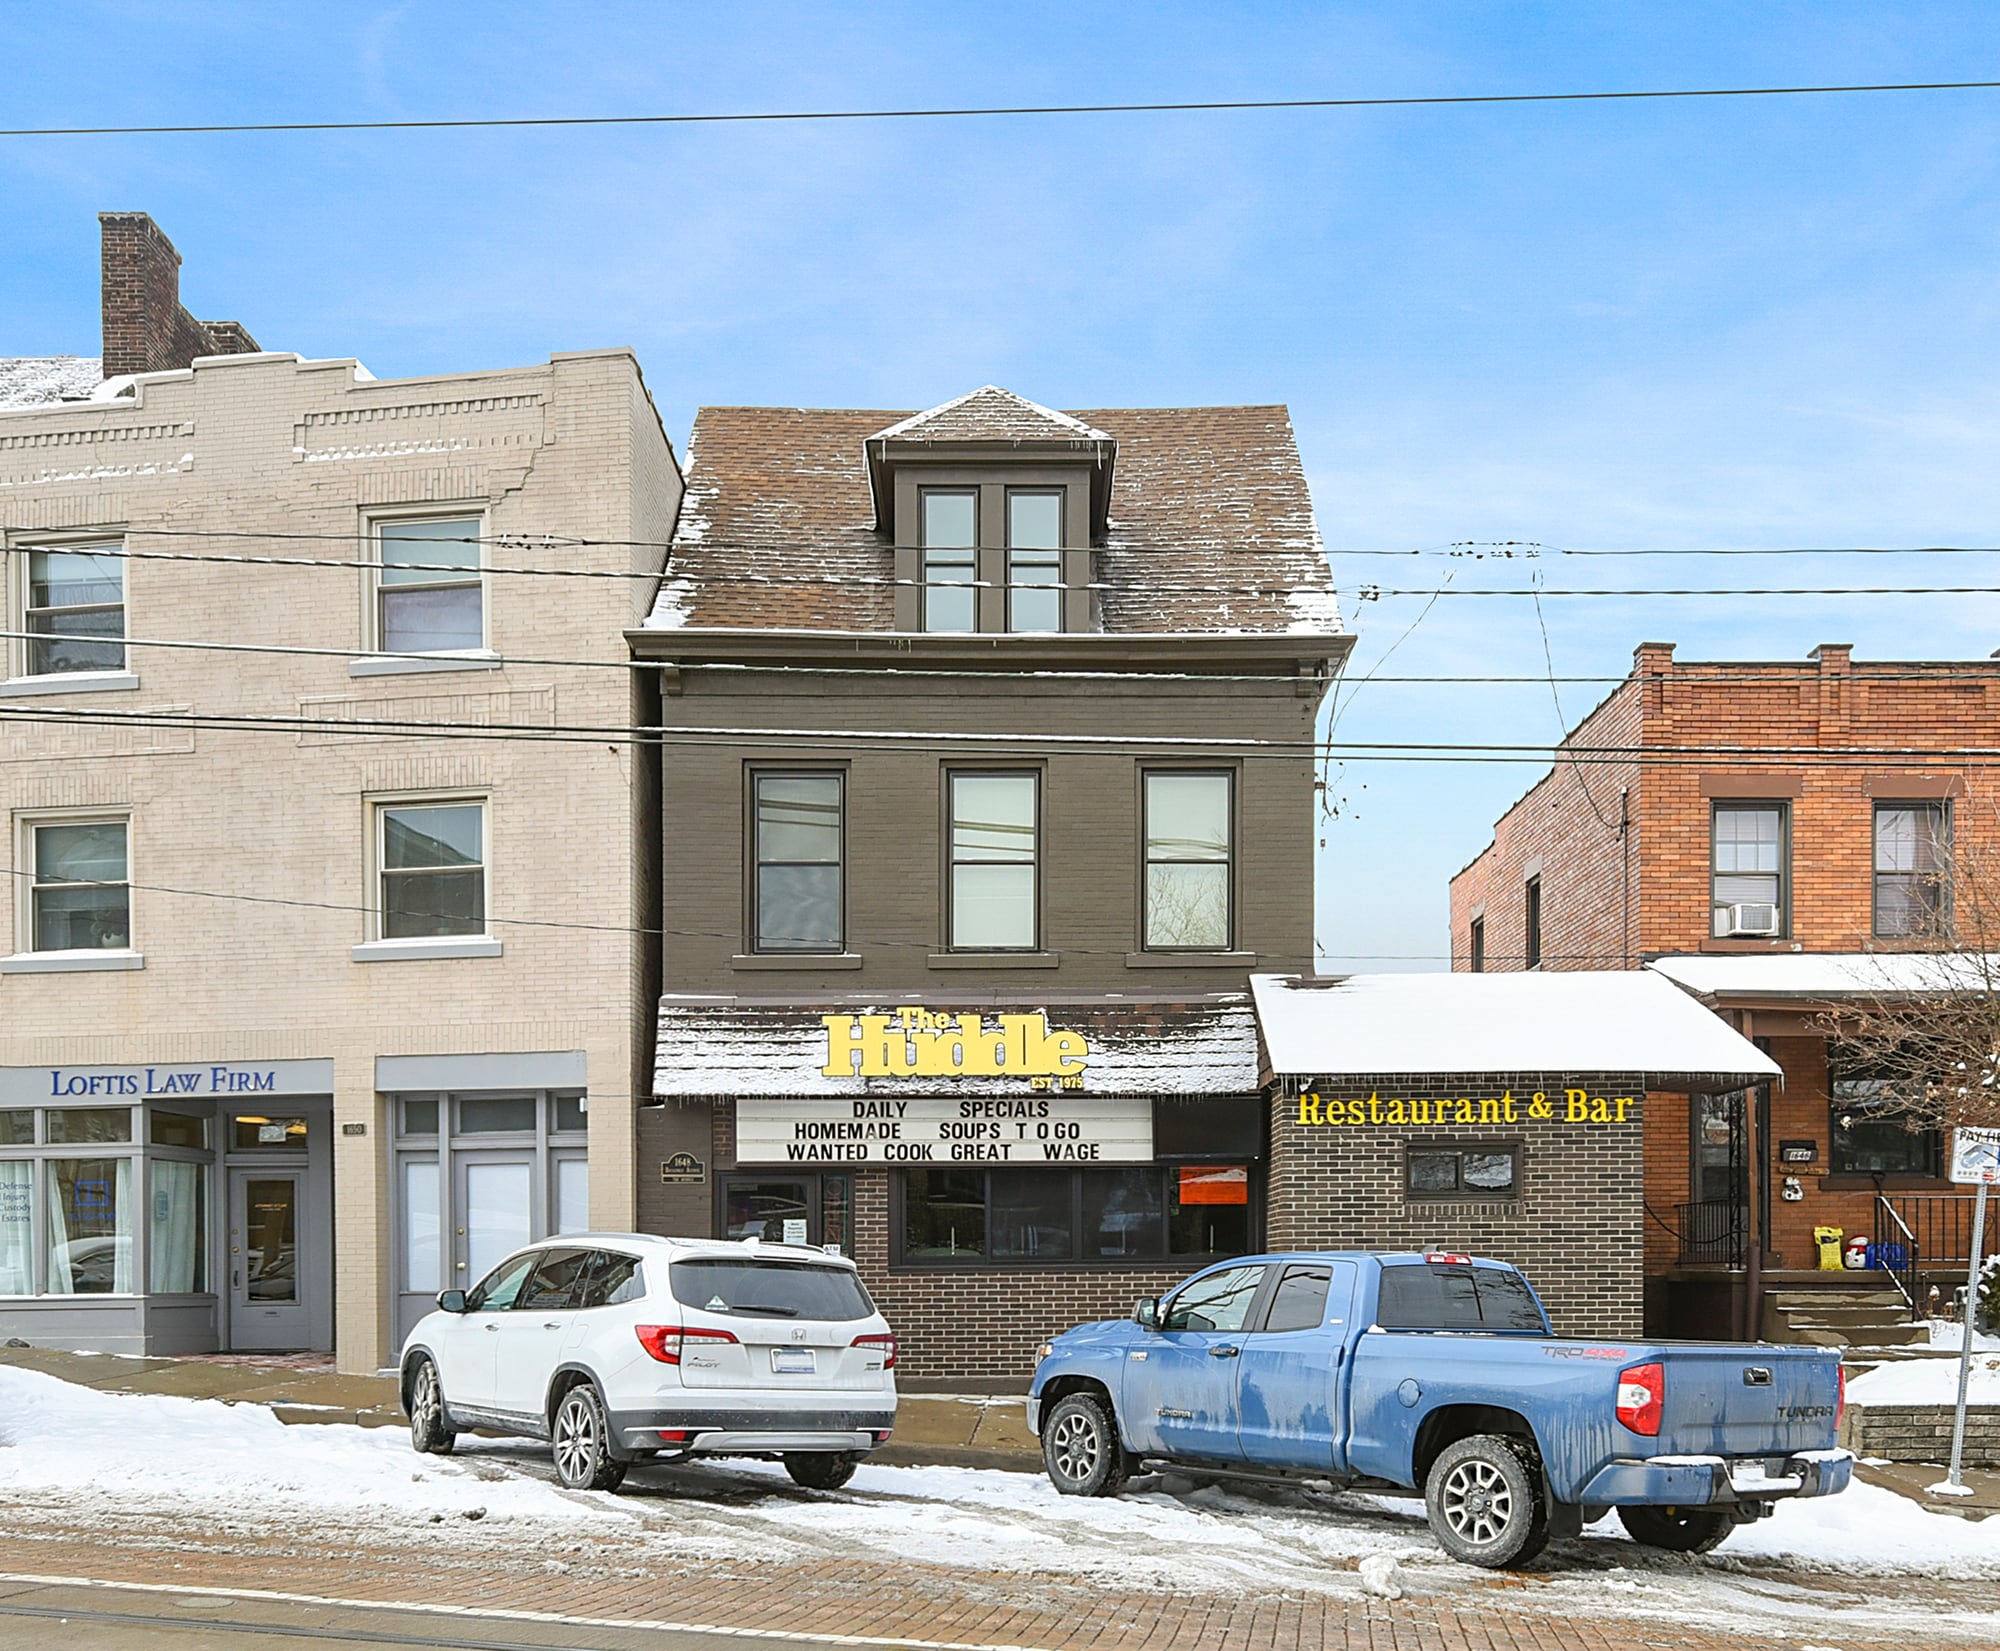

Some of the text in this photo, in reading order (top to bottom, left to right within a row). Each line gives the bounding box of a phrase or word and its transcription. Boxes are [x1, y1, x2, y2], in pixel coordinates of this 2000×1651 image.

[896, 1006, 950, 1029] The
[821, 1014, 1089, 1077] Huddle
[145, 1068, 202, 1094] LAW
[210, 1066, 275, 1092] FIRM
[1031, 1077, 1083, 1089] EST 1975
[853, 1100, 1049, 1118] DAILY SPECIALS
[1295, 1088, 1634, 1126] Restaurant & Bar
[795, 1122, 901, 1140] HOMEMADE
[939, 1122, 1001, 1139] SOUPS
[1959, 1130, 1982, 1142] PAY
[786, 1143, 1100, 1161] WANTED COOK GREAT WAGE
[1541, 1346, 1584, 1359] TRD
[1154, 1407, 1193, 1419] TUNDRA
[1777, 1405, 1834, 1418] TUNDRA
